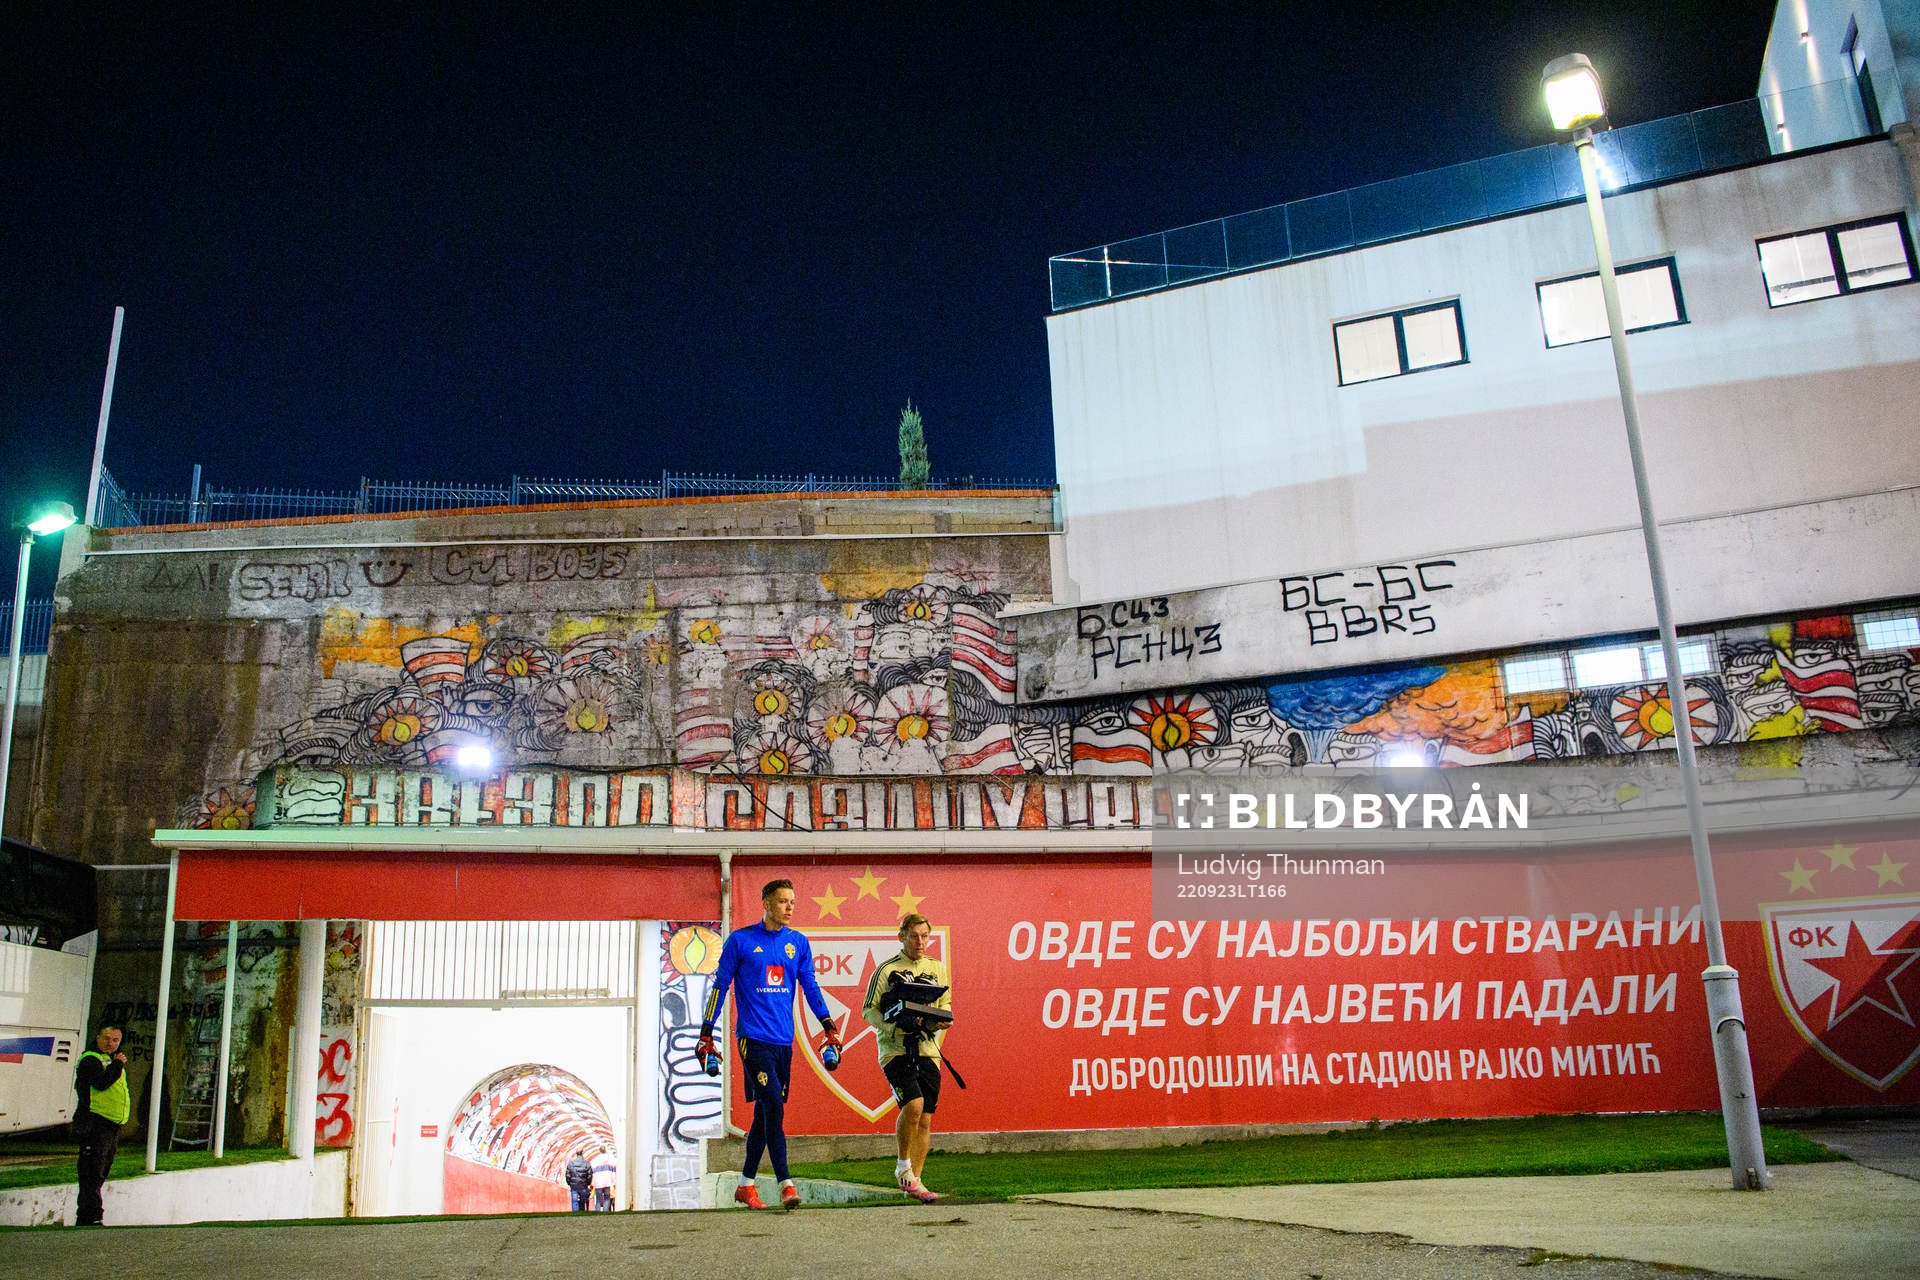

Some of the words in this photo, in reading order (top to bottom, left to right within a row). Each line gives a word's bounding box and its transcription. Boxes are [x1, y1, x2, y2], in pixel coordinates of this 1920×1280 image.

[1008, 921, 1136, 968] ОВДЕ
[1147, 920, 1207, 960] СУ
[1216, 917, 1439, 958] НАЈБОЉИ
[1452, 904, 1701, 954] СТВАРАНИ
[1788, 926, 1837, 948] ФК
[812, 953, 853, 975] ФК
[1043, 988, 1170, 1036] ОВДЕ
[1182, 986, 1242, 1026] СУ
[1252, 982, 1462, 1025] НАЈВЕЋИ
[1476, 973, 1677, 1026] ПАДАЛИ
[1070, 1055, 1274, 1097] ДОБРОДОШЛИ
[1281, 1053, 1321, 1086] НА
[1326, 1050, 1452, 1089] СТАДИОН
[1459, 1047, 1543, 1080] РАЈКО
[1551, 1043, 1659, 1077] МИТИЋ
